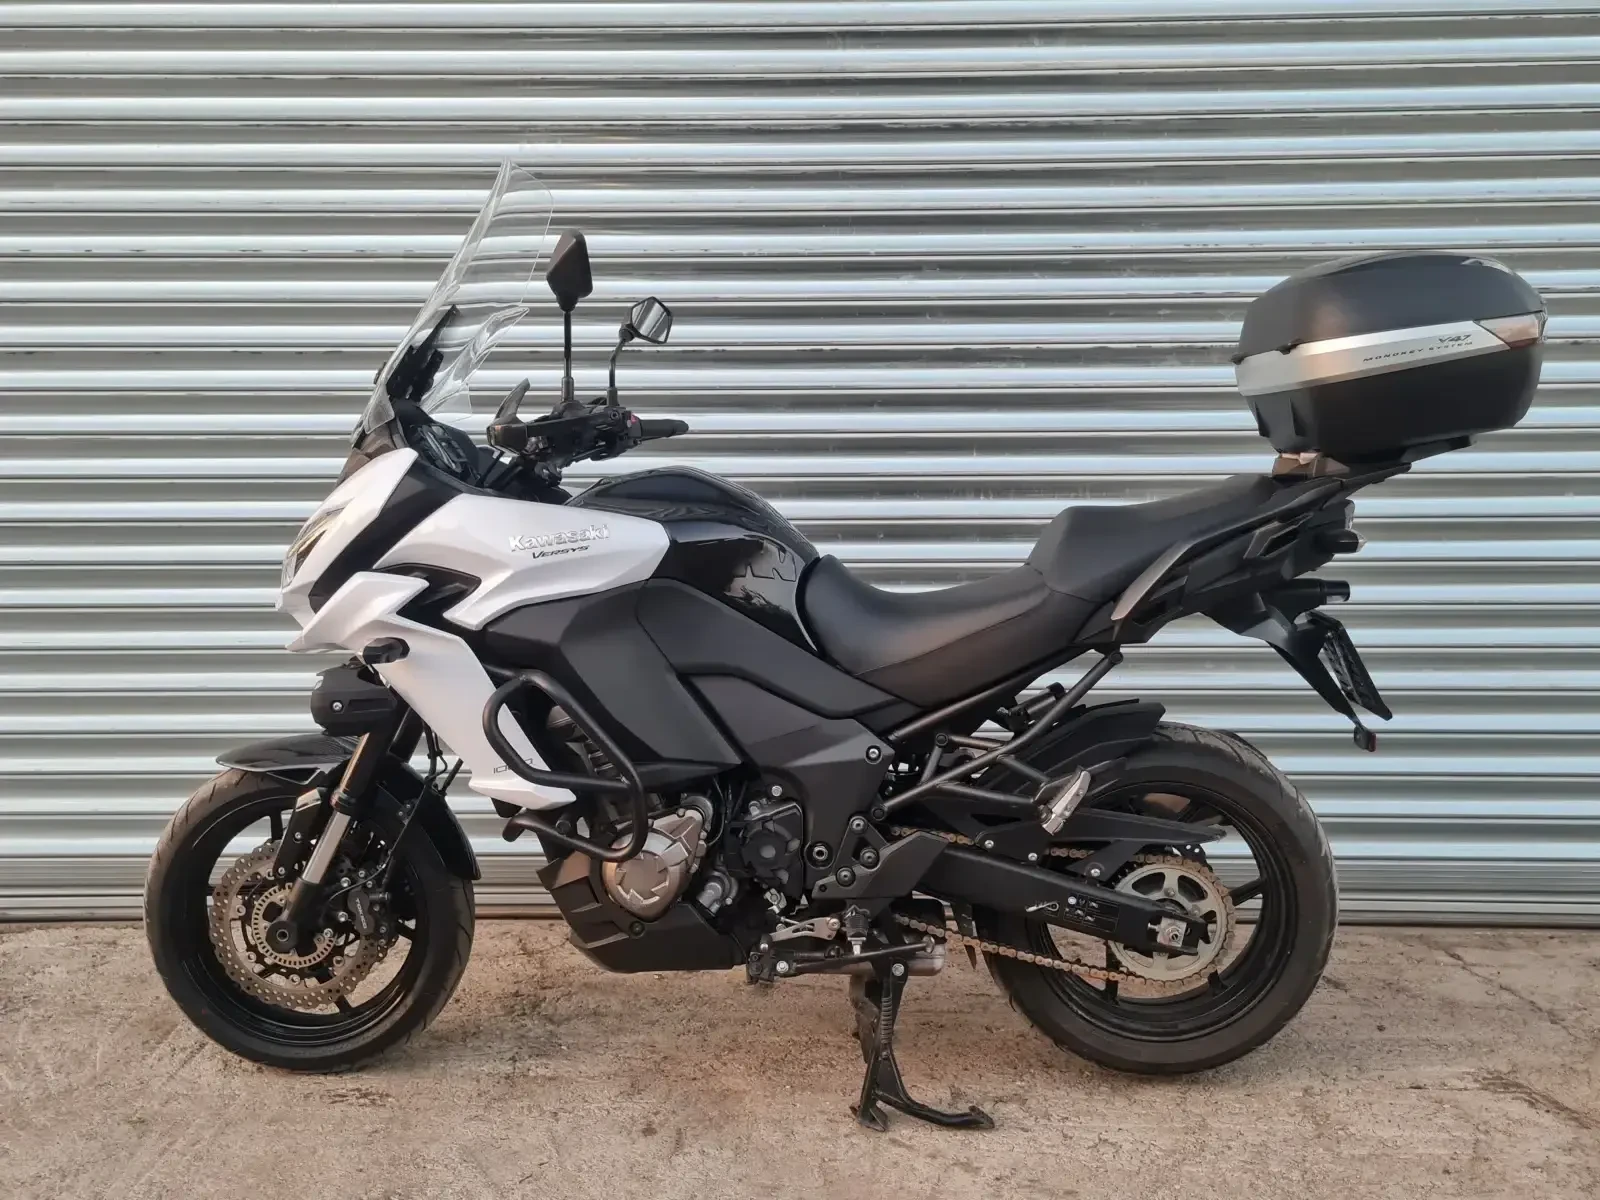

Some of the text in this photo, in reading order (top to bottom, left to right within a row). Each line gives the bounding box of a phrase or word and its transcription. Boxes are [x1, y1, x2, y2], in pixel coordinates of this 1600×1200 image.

[1363, 342, 1473, 362] MONOKEY SYSTEM
[508, 524, 610, 552] Kawasaki
[532, 545, 590, 559] VERSYS
